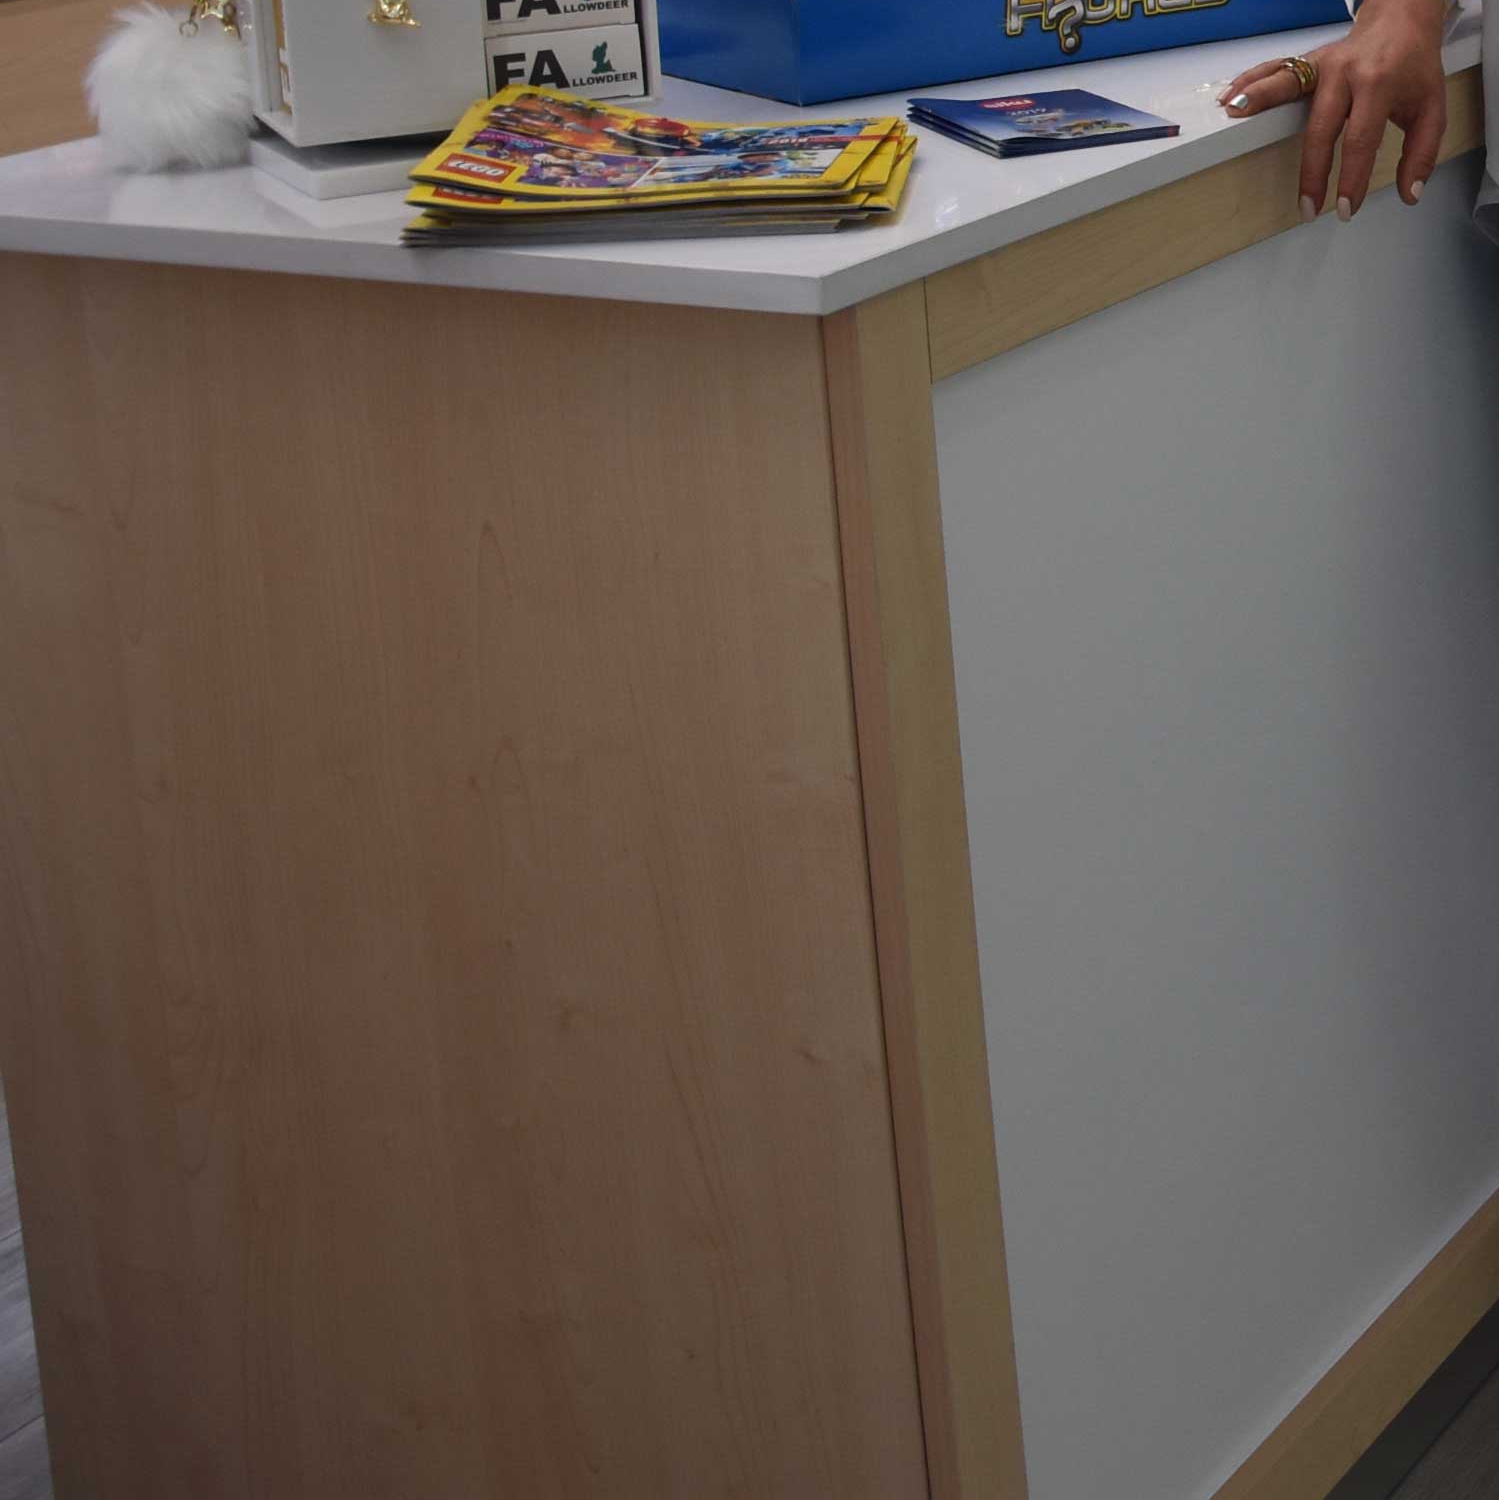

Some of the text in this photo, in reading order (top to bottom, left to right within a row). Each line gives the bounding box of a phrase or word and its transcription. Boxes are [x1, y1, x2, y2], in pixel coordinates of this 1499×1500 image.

[563, 0, 630, 14] LLOWDEER
[492, 48, 639, 90] FA LLOWDEER
[447, 159, 506, 178] LEGO
